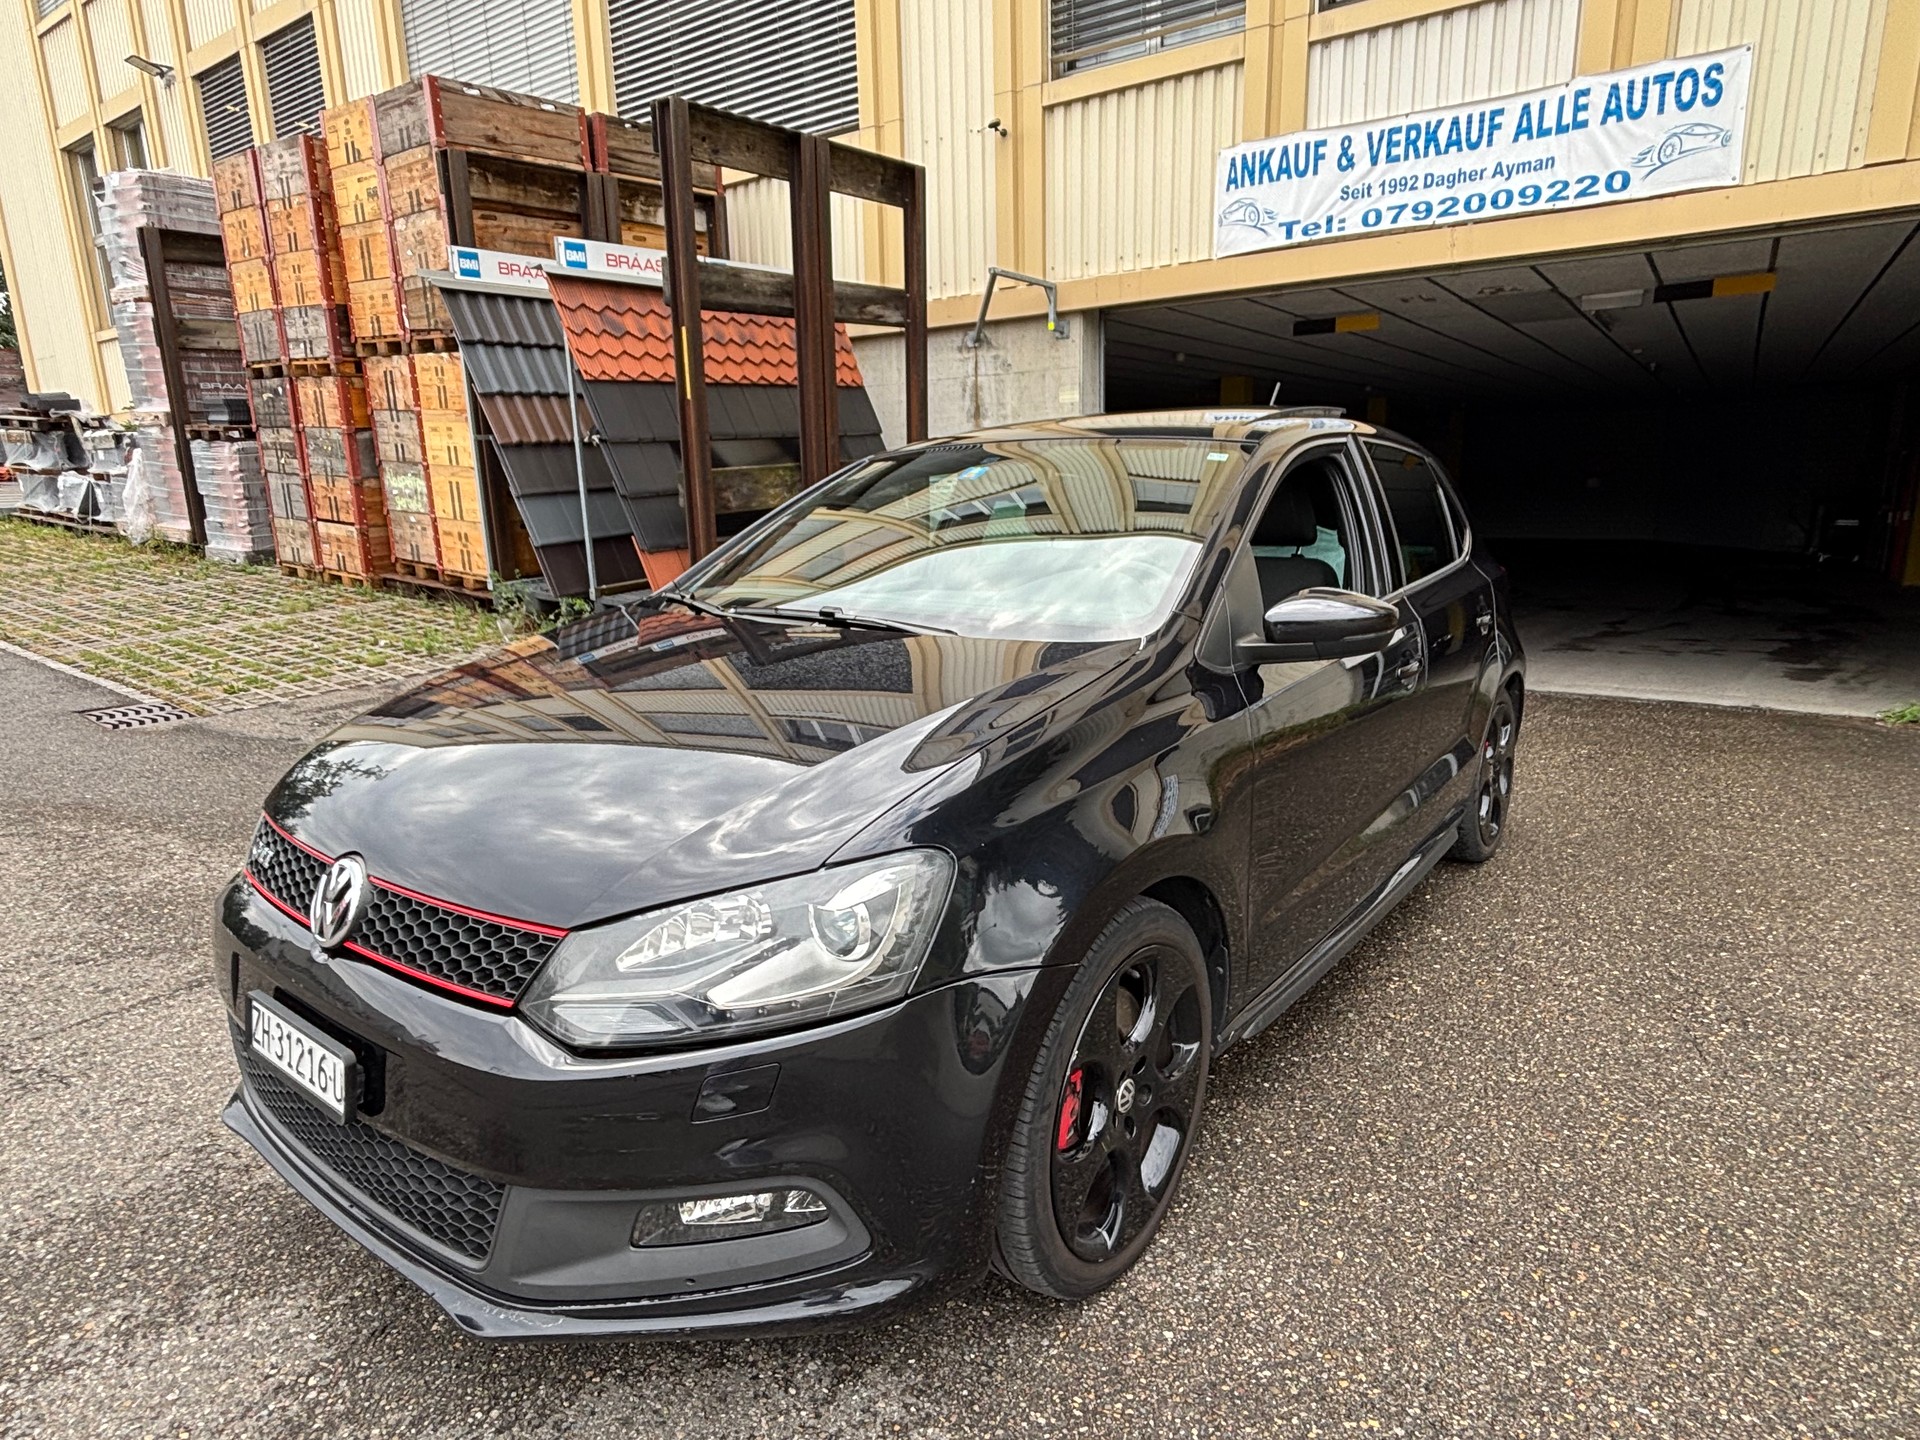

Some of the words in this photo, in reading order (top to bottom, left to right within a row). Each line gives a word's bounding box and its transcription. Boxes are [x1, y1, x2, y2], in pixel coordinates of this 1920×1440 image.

[1225, 138, 1328, 193] ANKAUF
[1336, 134, 1356, 173] &
[1366, 107, 1505, 167] VERKAUF
[1512, 87, 1592, 144] ALLE
[1600, 62, 1725, 126] AUTOS
[1339, 182, 1373, 201] Seit
[1378, 174, 1419, 196] 1992
[1422, 166, 1487, 190] Dagher
[1491, 155, 1556, 182] Ayman
[1278, 214, 1347, 241] Tel:
[1361, 170, 1632, 228] 0792009220
[459, 257, 480, 271] BMI
[498, 261, 548, 280] BRAA
[564, 249, 587, 263] BMI
